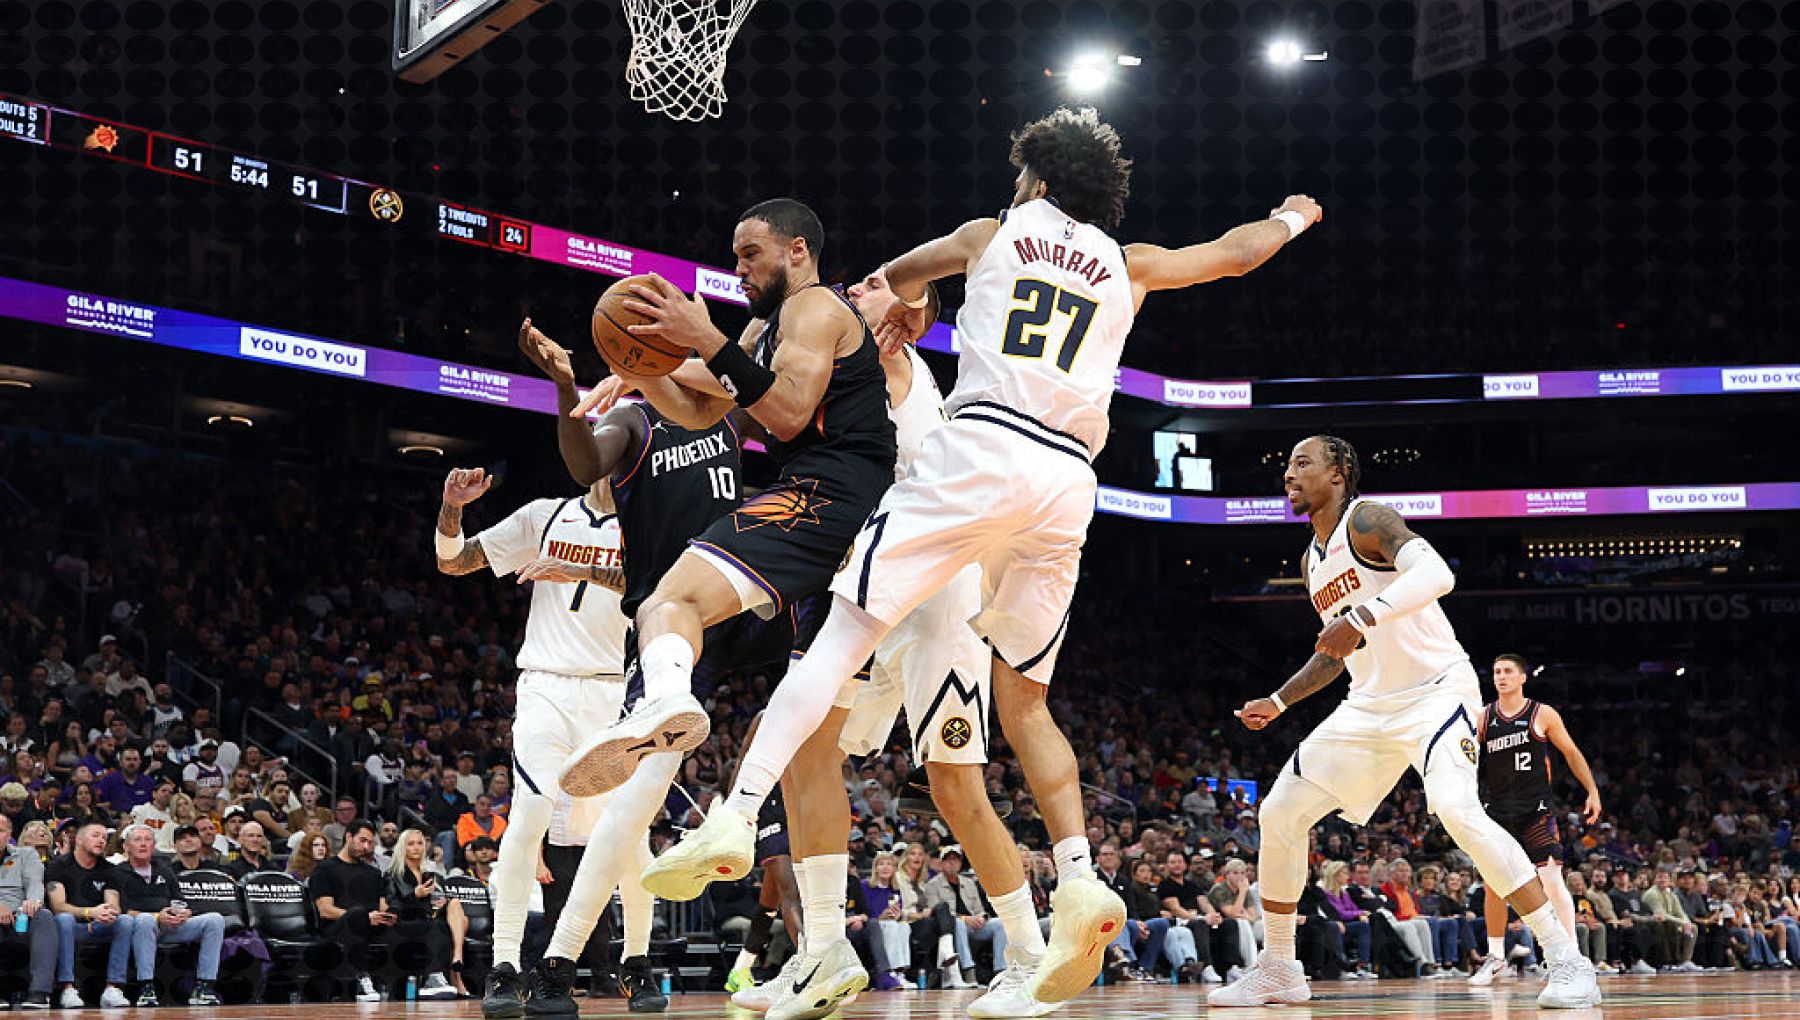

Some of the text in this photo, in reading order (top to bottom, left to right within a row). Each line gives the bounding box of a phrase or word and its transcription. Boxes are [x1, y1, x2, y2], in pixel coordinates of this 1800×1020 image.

[29, 106, 38, 121] 5
[28, 123, 36, 138] 2
[175, 147, 202, 172] 51
[231, 164, 268, 188] 5:44
[293, 175, 318, 199] 51
[439, 204, 447, 219] 5
[439, 219, 447, 233] 2
[505, 226, 523, 245] 24
[568, 237, 596, 253] GILA
[597, 244, 632, 261] RIVER
[1013, 237, 1112, 287] MURRAY
[704, 276, 731, 292] YOU
[67, 295, 104, 312] GILA
[106, 302, 154, 322] RIVER
[1001, 277, 1101, 375] 27
[251, 336, 358, 366] YOU DO YOU
[440, 365, 470, 381] GILA
[471, 371, 510, 388] RIVER
[1505, 381, 1532, 392] YOU
[1729, 374, 1757, 384] YOU
[1762, 374, 1781, 384] DO
[1170, 387, 1247, 400] YOU DO YOU
[651, 430, 731, 478] PHOENIX
[707, 466, 736, 501] 10
[1102, 495, 1166, 513] YOU DO YOU
[1408, 500, 1435, 510] YOU
[1656, 492, 1740, 504] YOU DO YOU
[548, 540, 623, 567] NUGGETS
[1574, 594, 1750, 623] HORNITOS
[1486, 730, 1530, 754] PHOENIX
[1514, 752, 1532, 771] 12
[202, 882, 235, 891] RIVER
